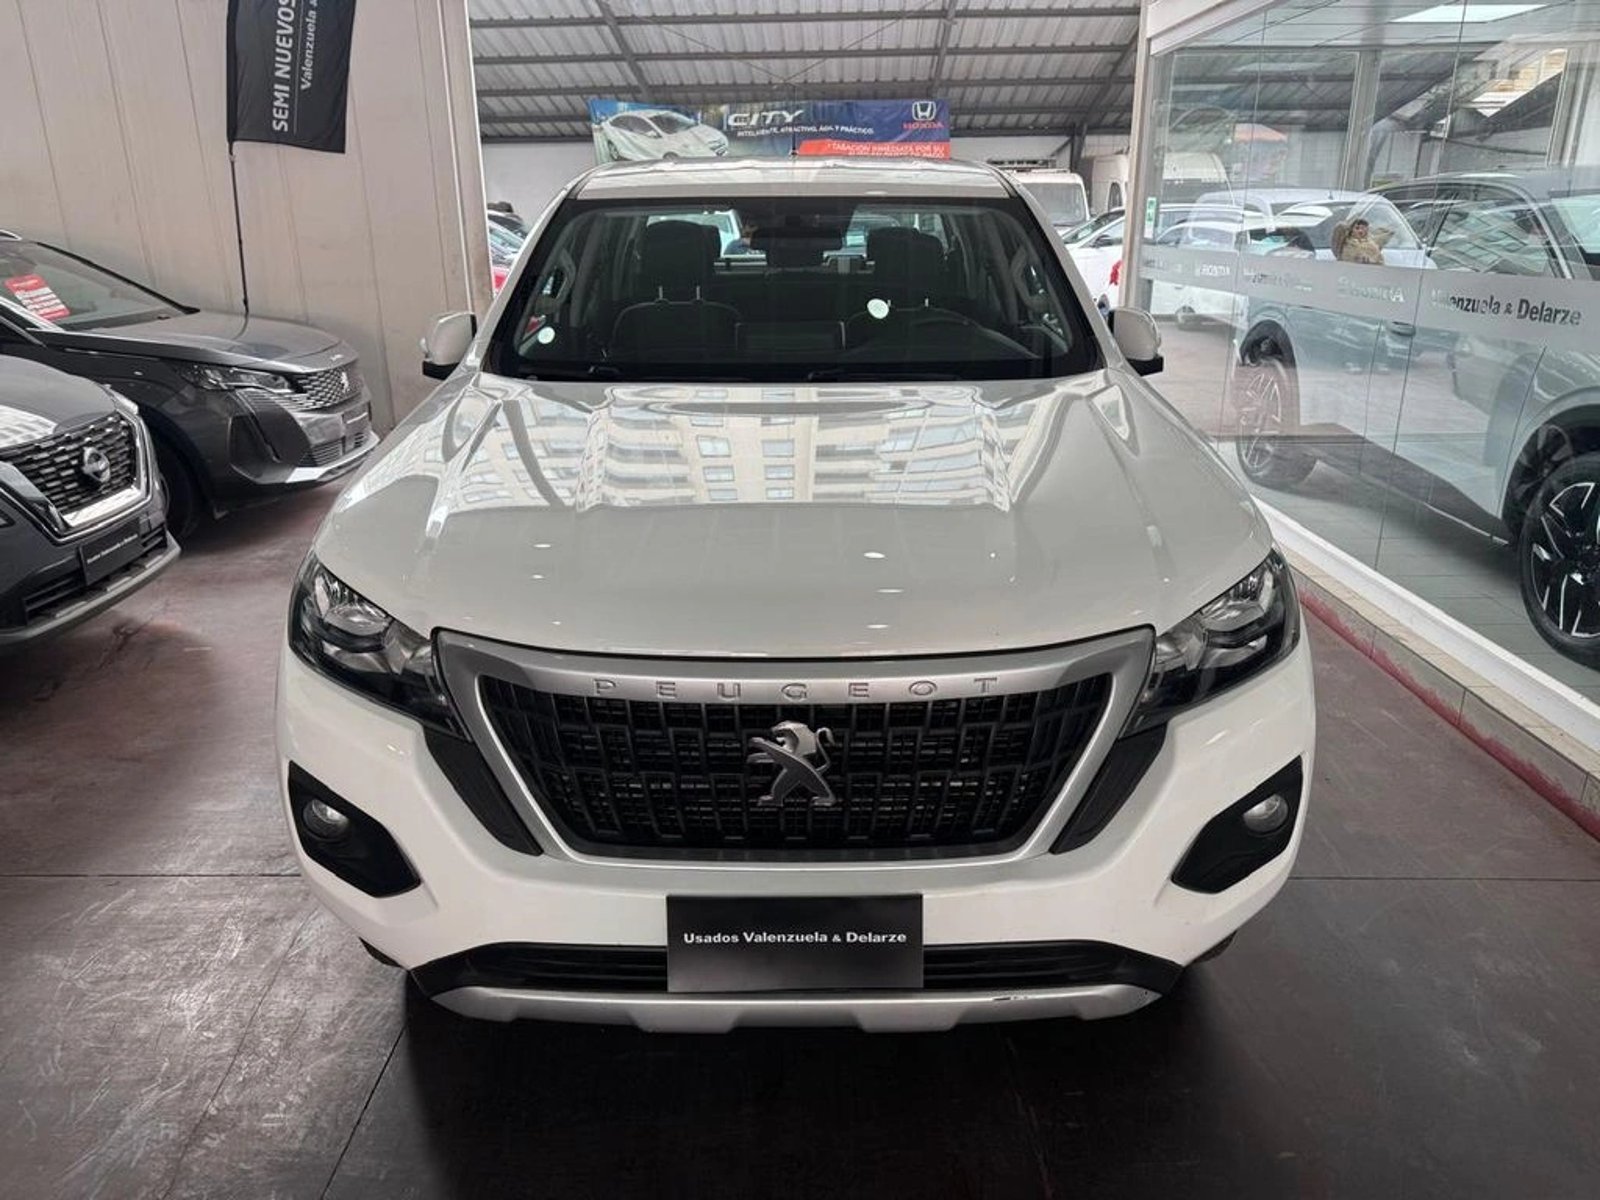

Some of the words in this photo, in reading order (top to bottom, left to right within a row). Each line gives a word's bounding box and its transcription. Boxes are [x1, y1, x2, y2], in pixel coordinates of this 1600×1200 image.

[300, 10, 317, 91] Valenzuela
[272, 84, 290, 132] SEMI
[727, 109, 804, 126] CITY
[1432, 287, 1501, 315] enzuela
[1517, 298, 1582, 326] Delarze
[592, 676, 998, 699] PEUGEOT
[683, 932, 740, 944] Usados
[743, 931, 828, 944] Valenzuela
[832, 934, 842, 943] &
[845, 931, 908, 944] Delarze
